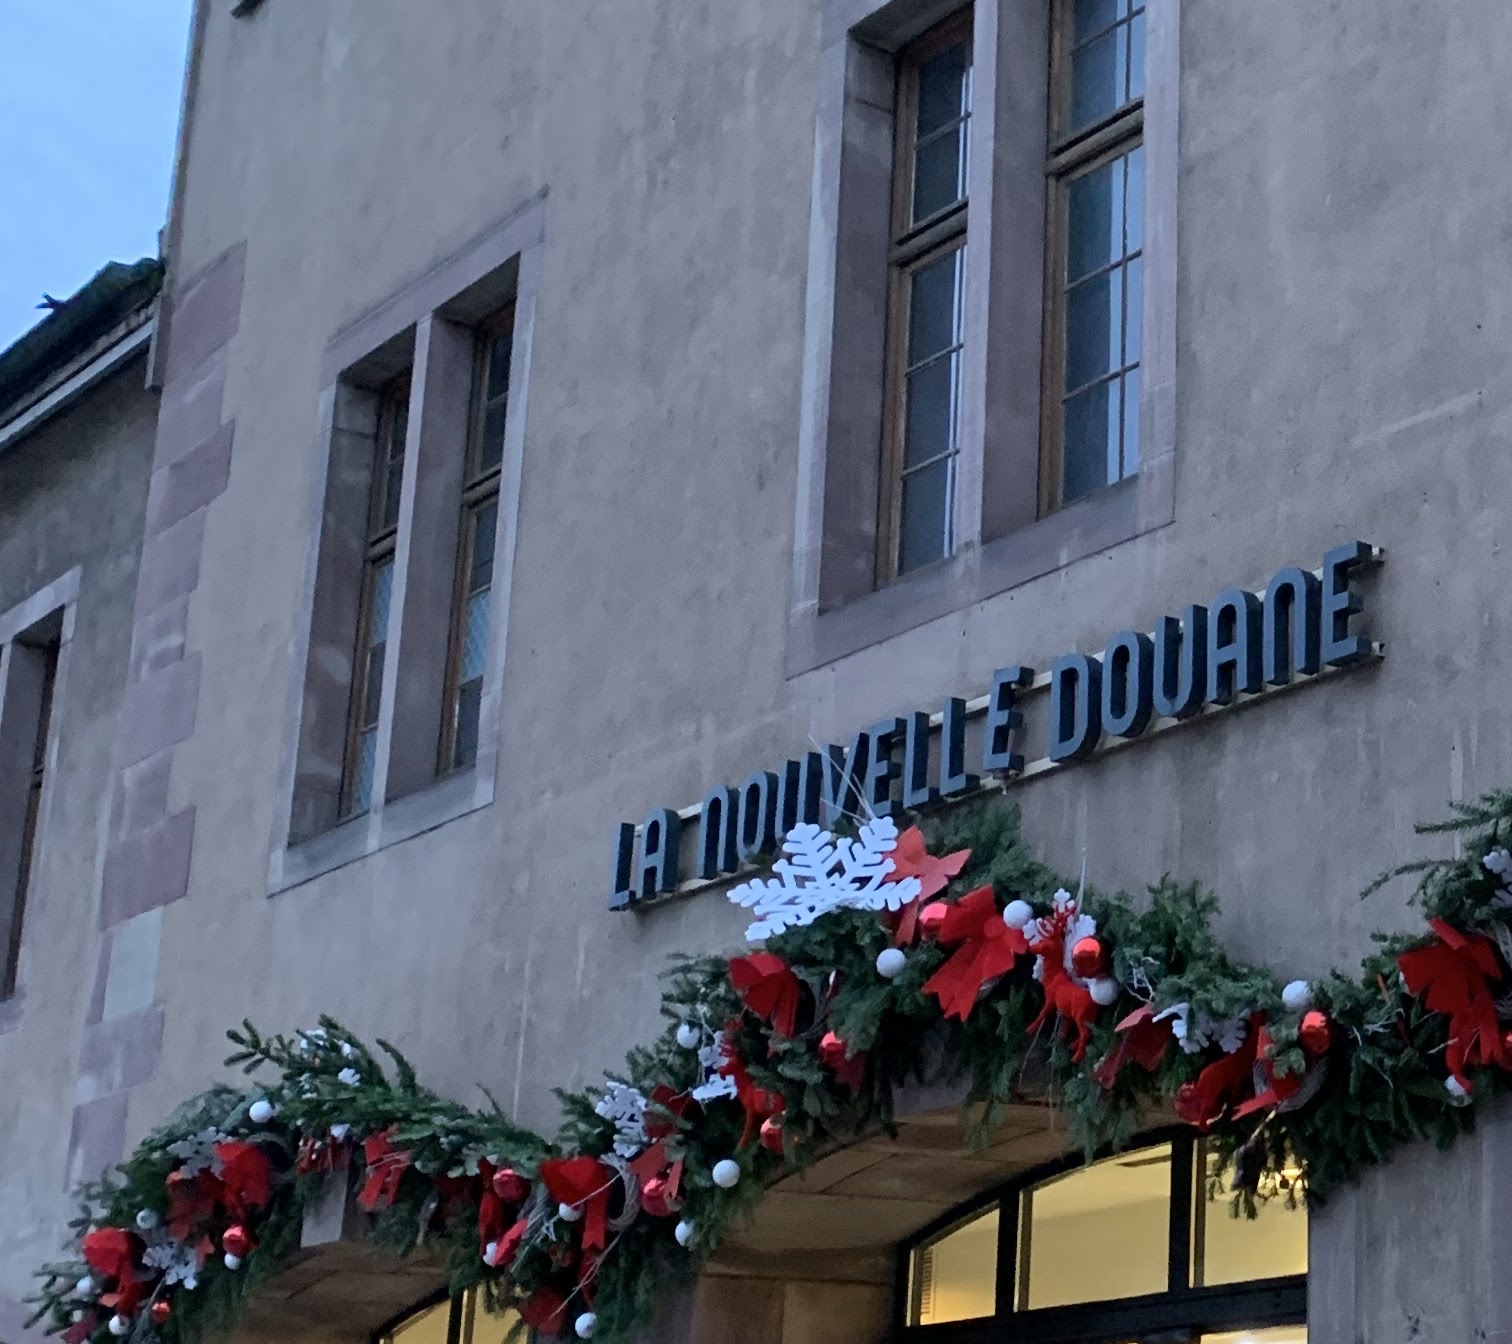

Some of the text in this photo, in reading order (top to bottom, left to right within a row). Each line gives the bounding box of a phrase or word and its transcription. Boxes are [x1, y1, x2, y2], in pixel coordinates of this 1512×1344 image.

[608, 540, 1374, 912] LA NOUVELLE DOUANE
